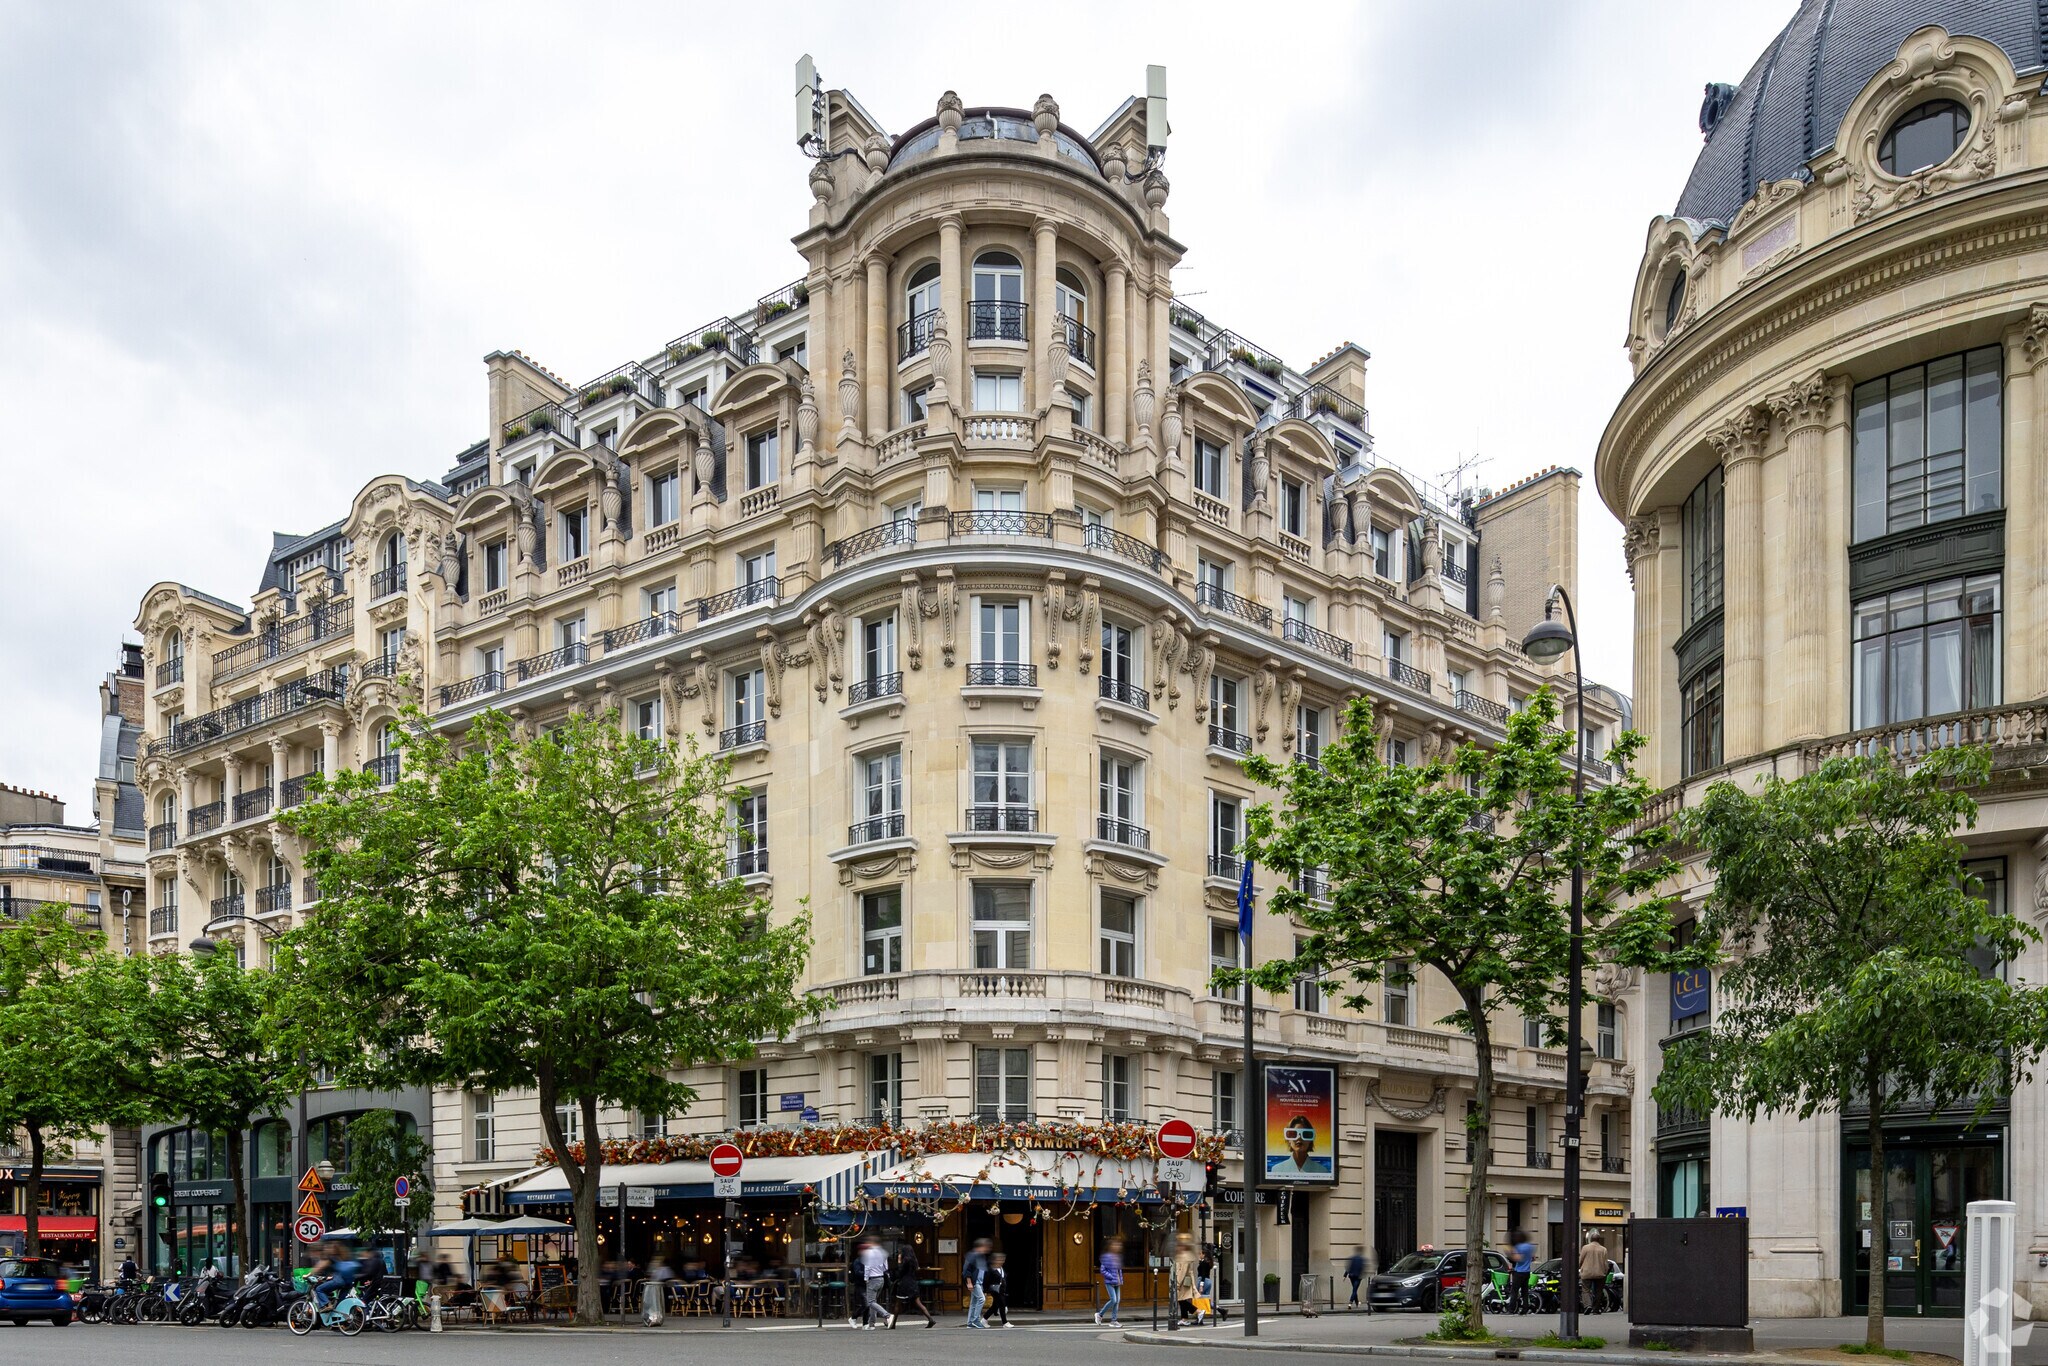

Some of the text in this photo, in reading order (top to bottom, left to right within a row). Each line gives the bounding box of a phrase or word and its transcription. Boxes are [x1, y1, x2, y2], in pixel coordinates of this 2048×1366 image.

[1677, 974, 1703, 995] LCL
[992, 1137, 1080, 1149] LE GRAMONT
[760, 1185, 789, 1193] COCKTAILS
[1013, 1189, 1021, 1197] LE
[1224, 1190, 1266, 1203] COIFRE
[301, 1224, 319, 1236] 30
